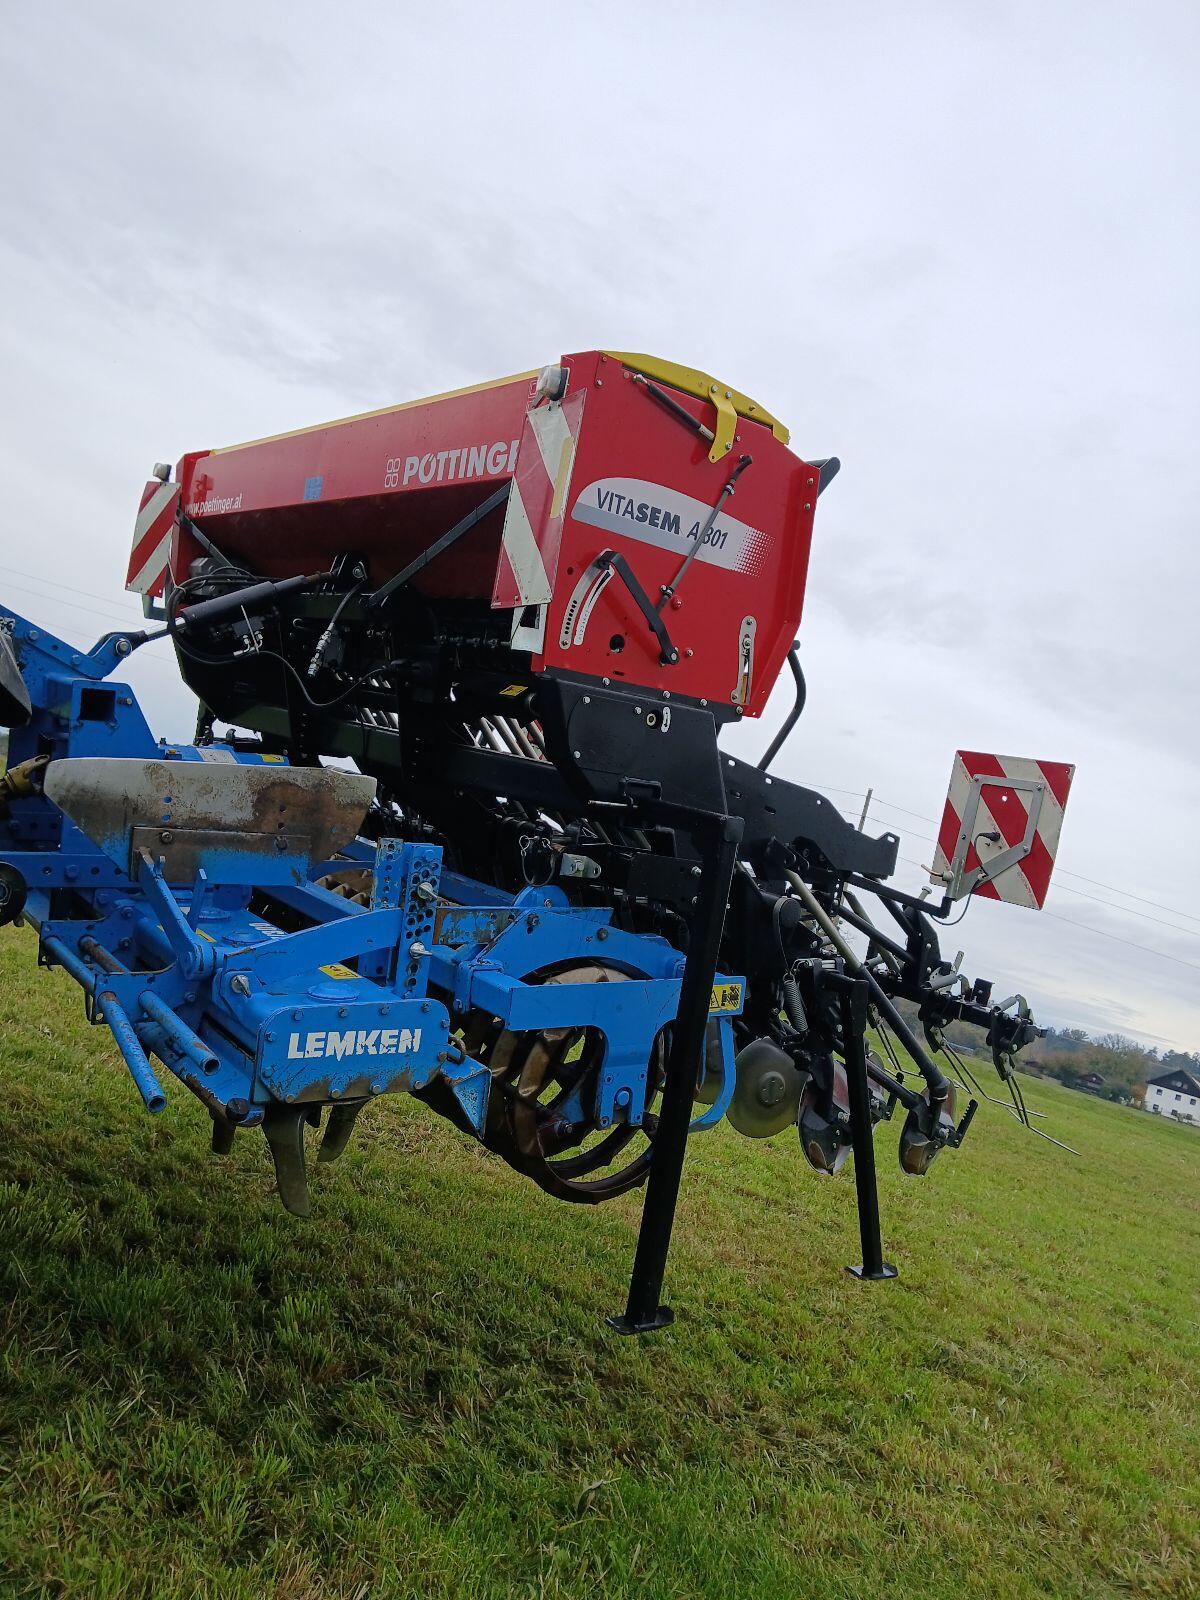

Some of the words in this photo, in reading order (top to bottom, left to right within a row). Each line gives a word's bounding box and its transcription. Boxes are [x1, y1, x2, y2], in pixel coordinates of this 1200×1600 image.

[597, 487, 681, 535] VITASEM
[686, 521, 701, 541] A
[702, 526, 729, 550] 301
[287, 1028, 422, 1062] LEMKEN
